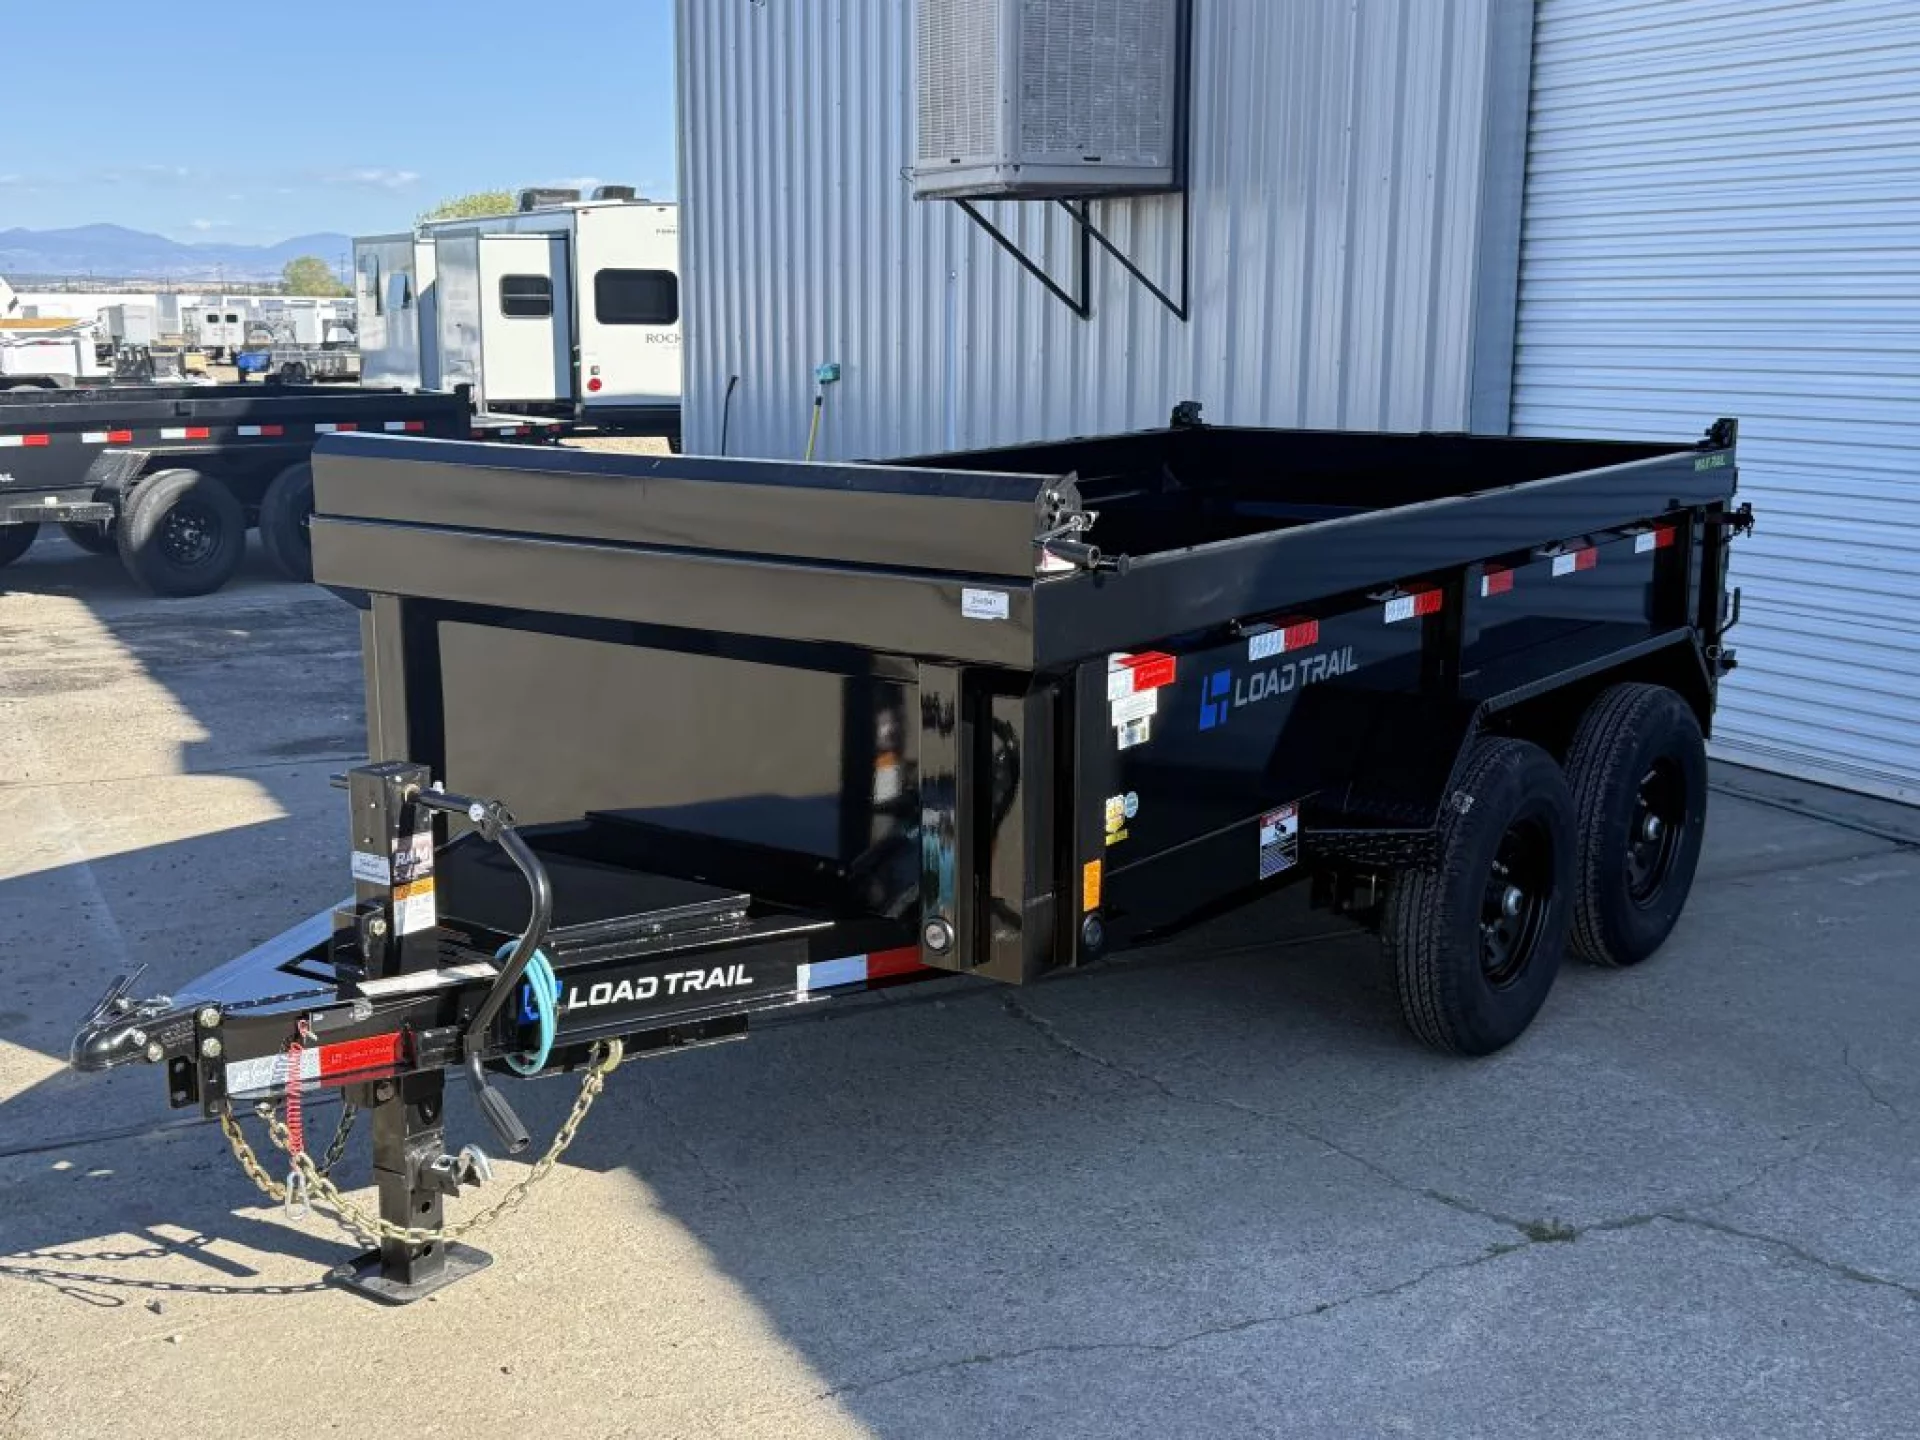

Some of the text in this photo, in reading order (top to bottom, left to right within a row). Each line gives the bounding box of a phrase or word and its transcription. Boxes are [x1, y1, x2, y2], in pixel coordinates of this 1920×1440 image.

[1234, 664, 1296, 707] LOAD
[1299, 645, 1359, 685] TRAIL
[567, 976, 659, 1010] LOAD
[664, 963, 754, 995] TRAIL
